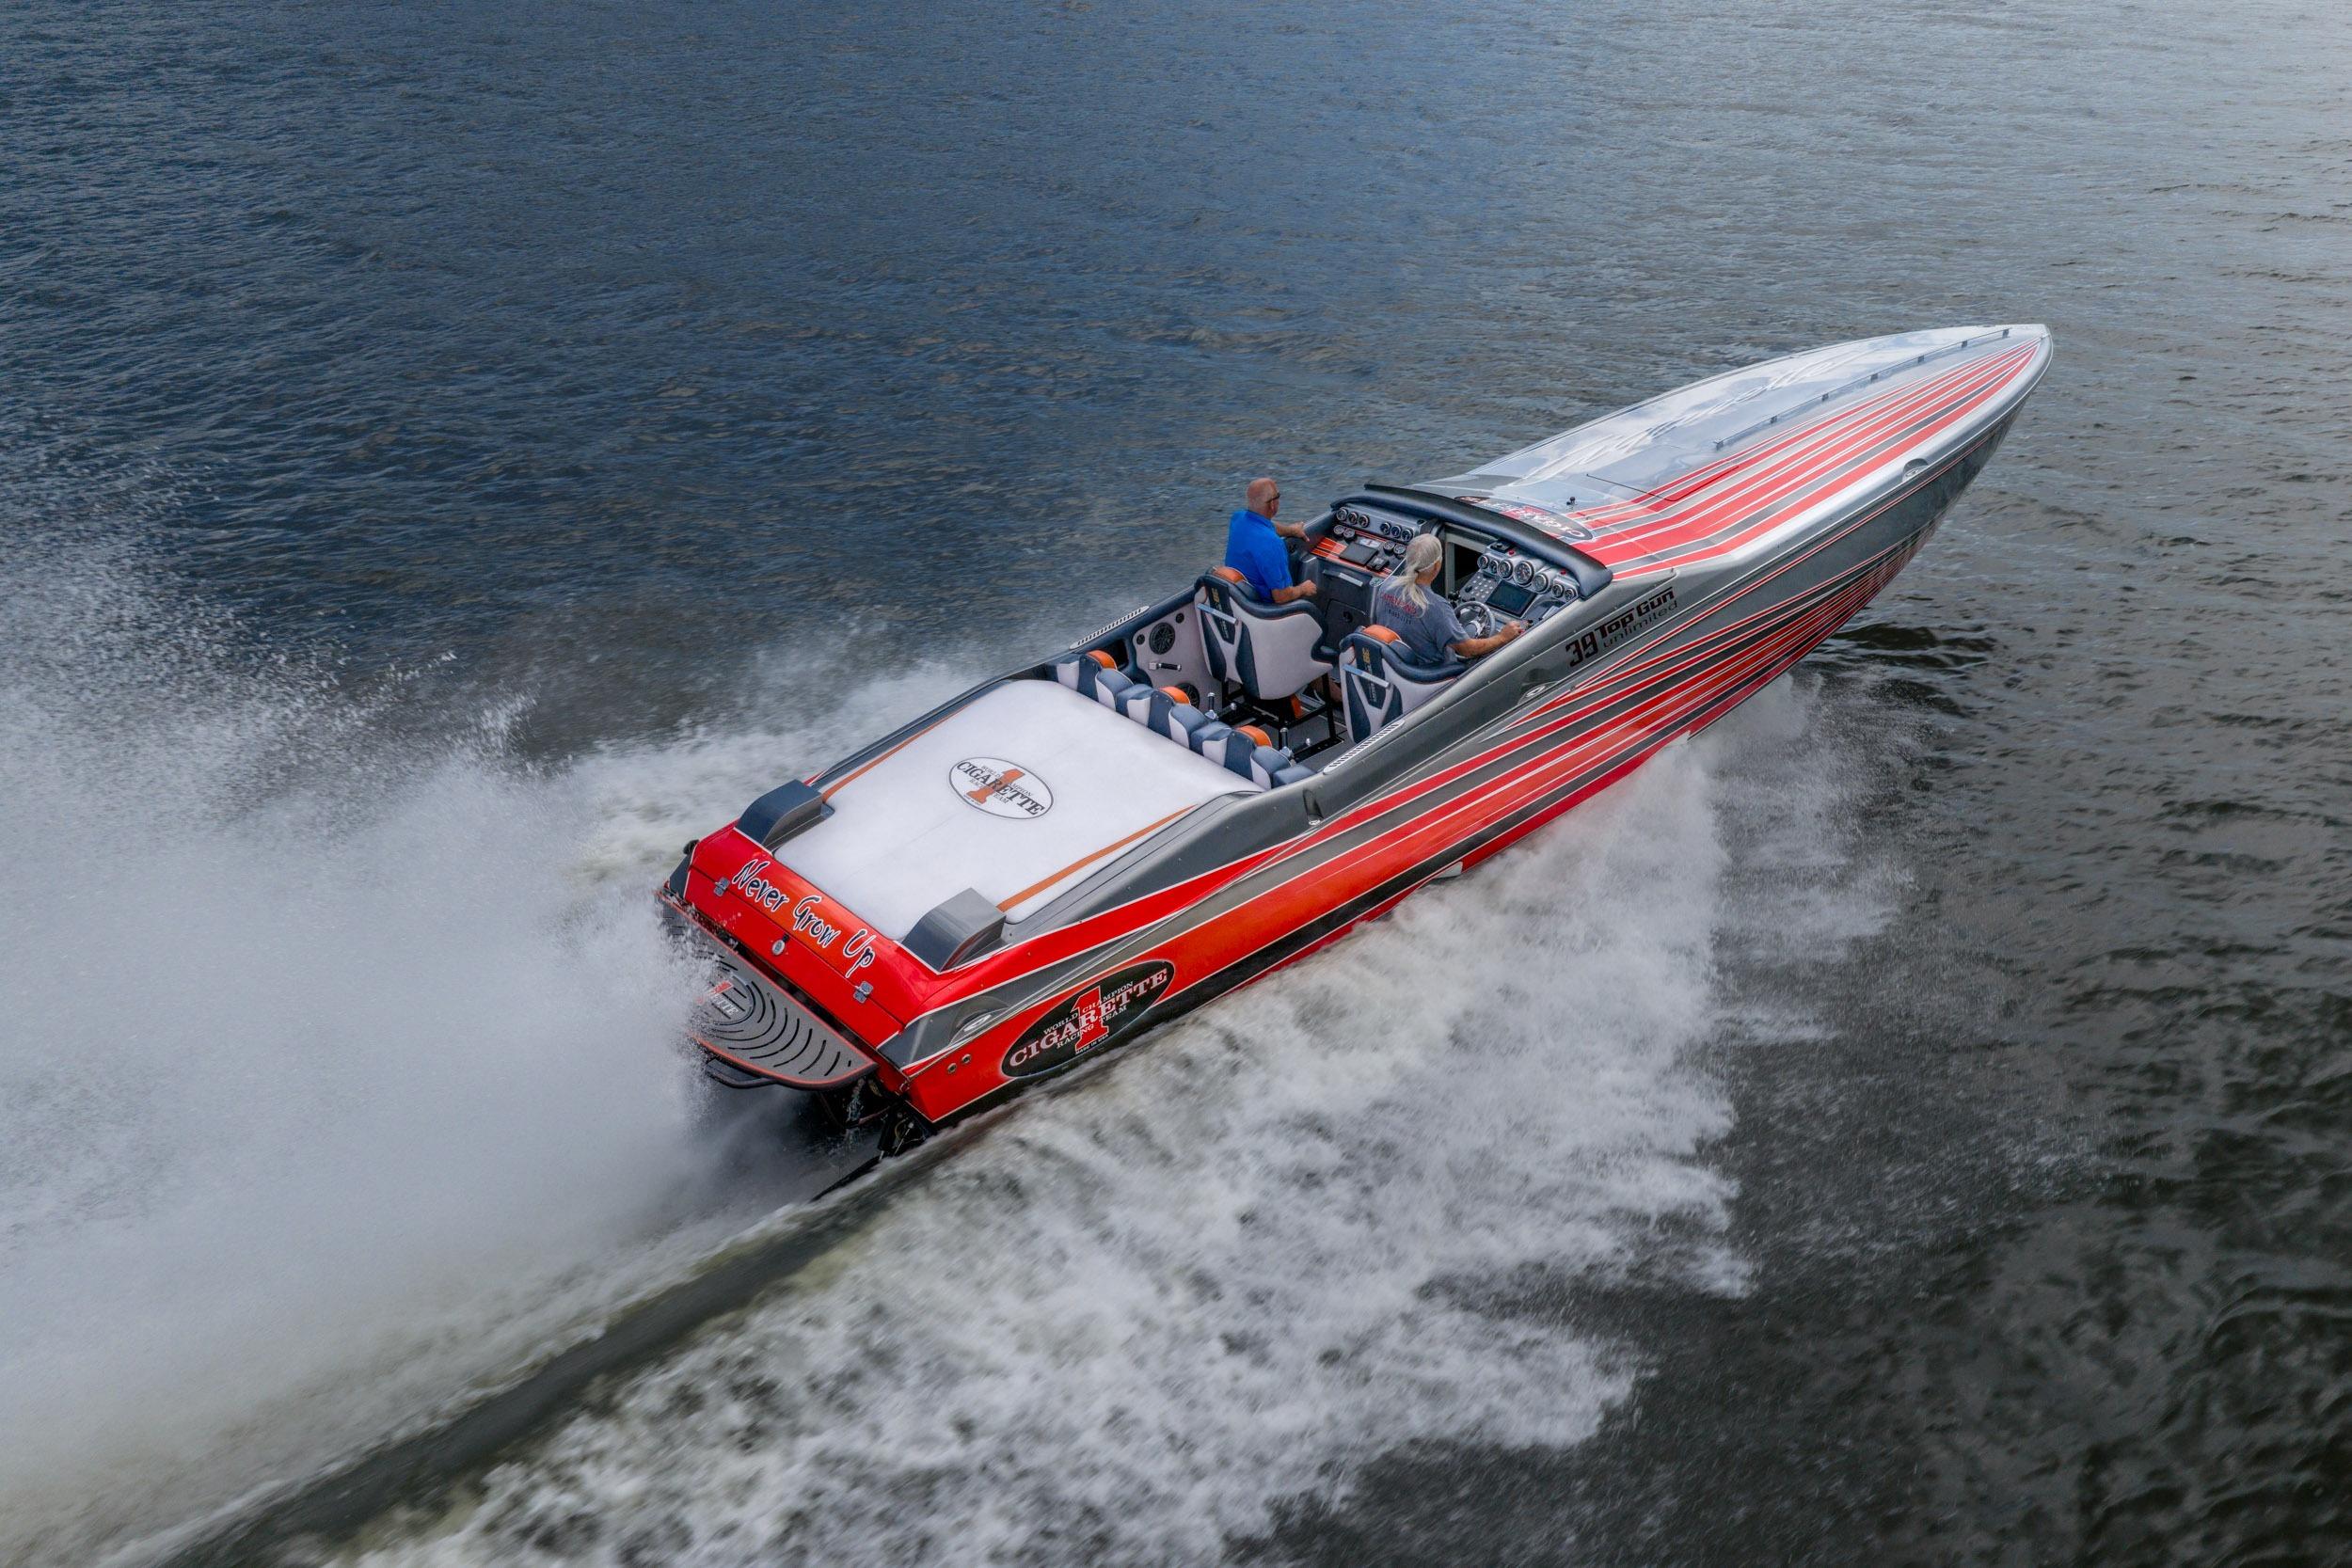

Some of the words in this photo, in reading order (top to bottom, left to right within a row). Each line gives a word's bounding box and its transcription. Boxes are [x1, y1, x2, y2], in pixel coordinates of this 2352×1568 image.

[1565, 631, 1598, 667] 39
[1595, 608, 1635, 639] Top
[1636, 586, 1675, 616] Gun
[1603, 600, 1677, 648] unlimited
[957, 761, 1045, 816] CIGARETTE
[966, 768, 1025, 804] 1
[732, 858, 789, 912] Never
[793, 895, 841, 948] Grow
[843, 928, 877, 978] Up
[1009, 968, 1168, 1067] CIGARETTE
[1042, 1013, 1078, 1035] WORLD
[1082, 980, 1134, 1014] CHAMPION
[1056, 1023, 1094, 1050] RACING
[1099, 1005, 1127, 1022] TEAM
[1071, 985, 1109, 1053] 1
